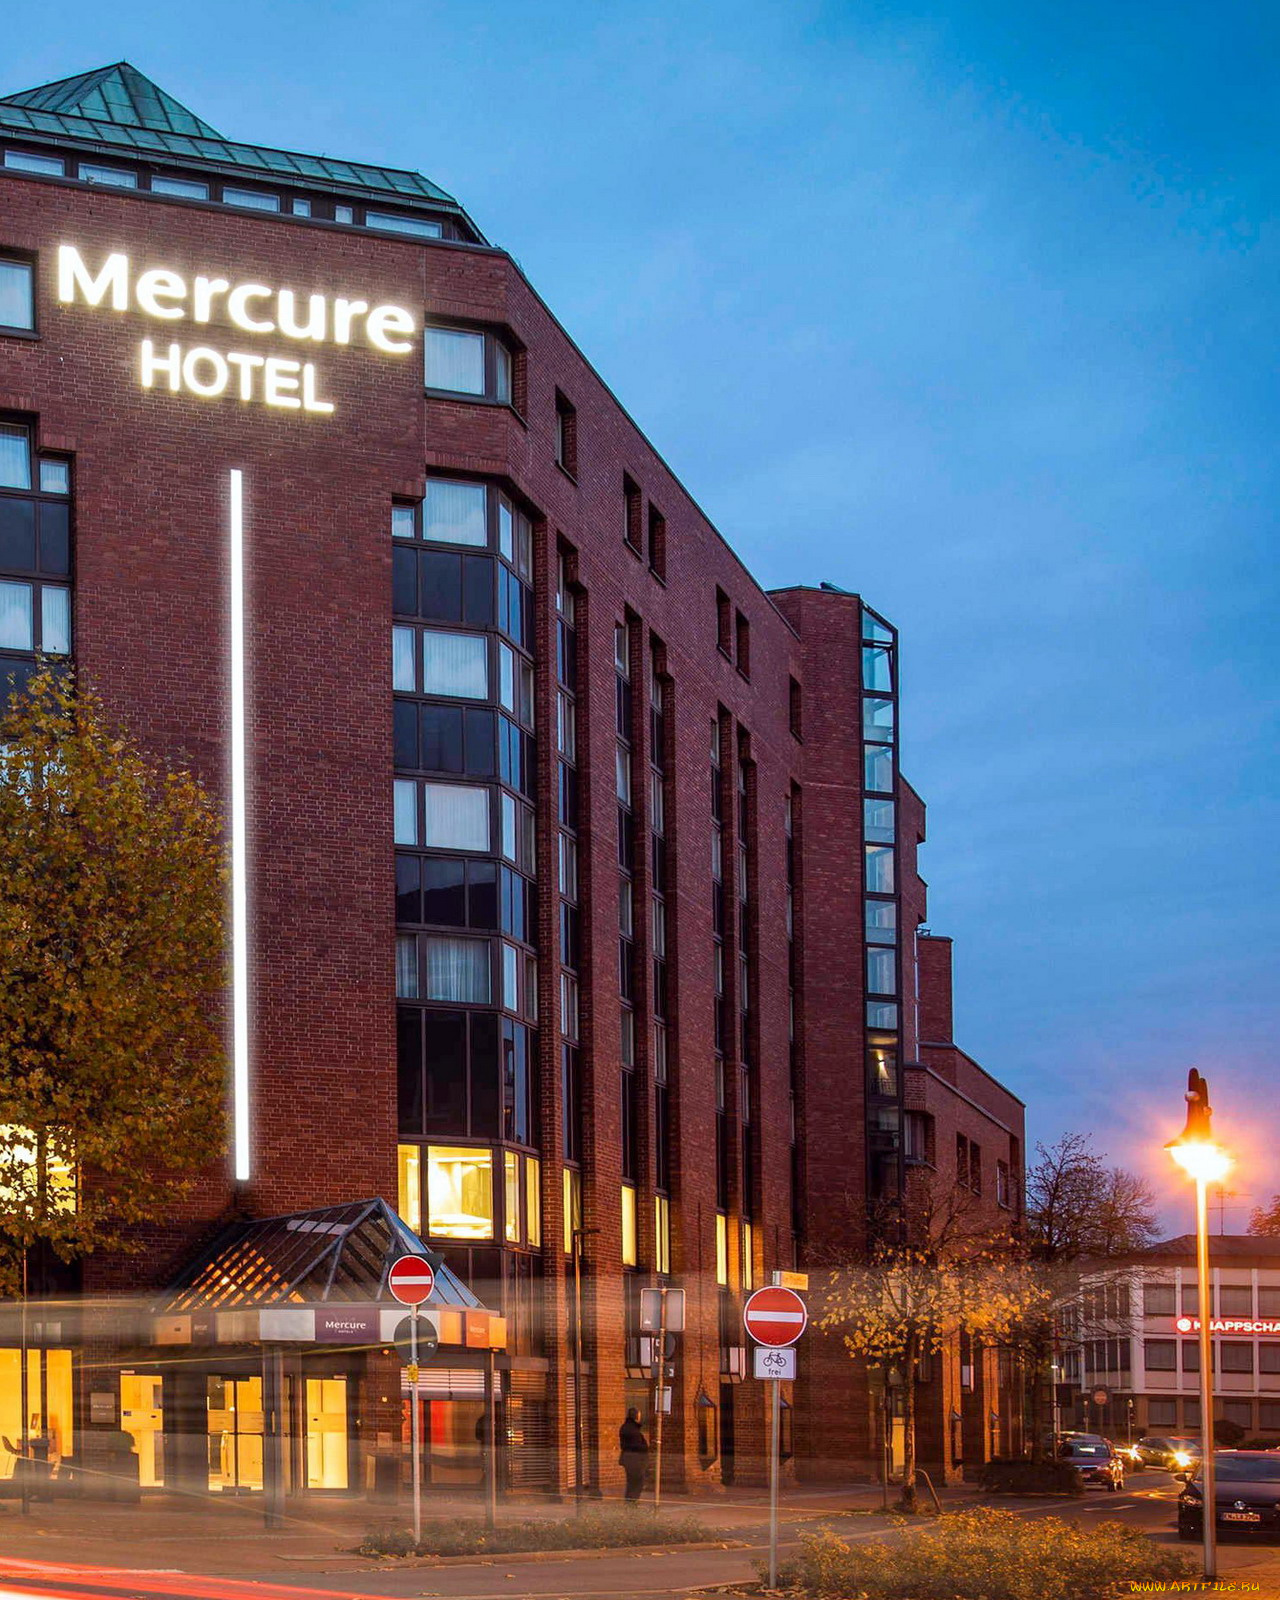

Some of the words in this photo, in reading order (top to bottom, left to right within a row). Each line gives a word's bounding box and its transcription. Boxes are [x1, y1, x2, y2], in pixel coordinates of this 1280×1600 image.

[58, 245, 415, 354] Mercure
[141, 339, 334, 413] HOTEL
[325, 1321, 366, 1329] Mercure
